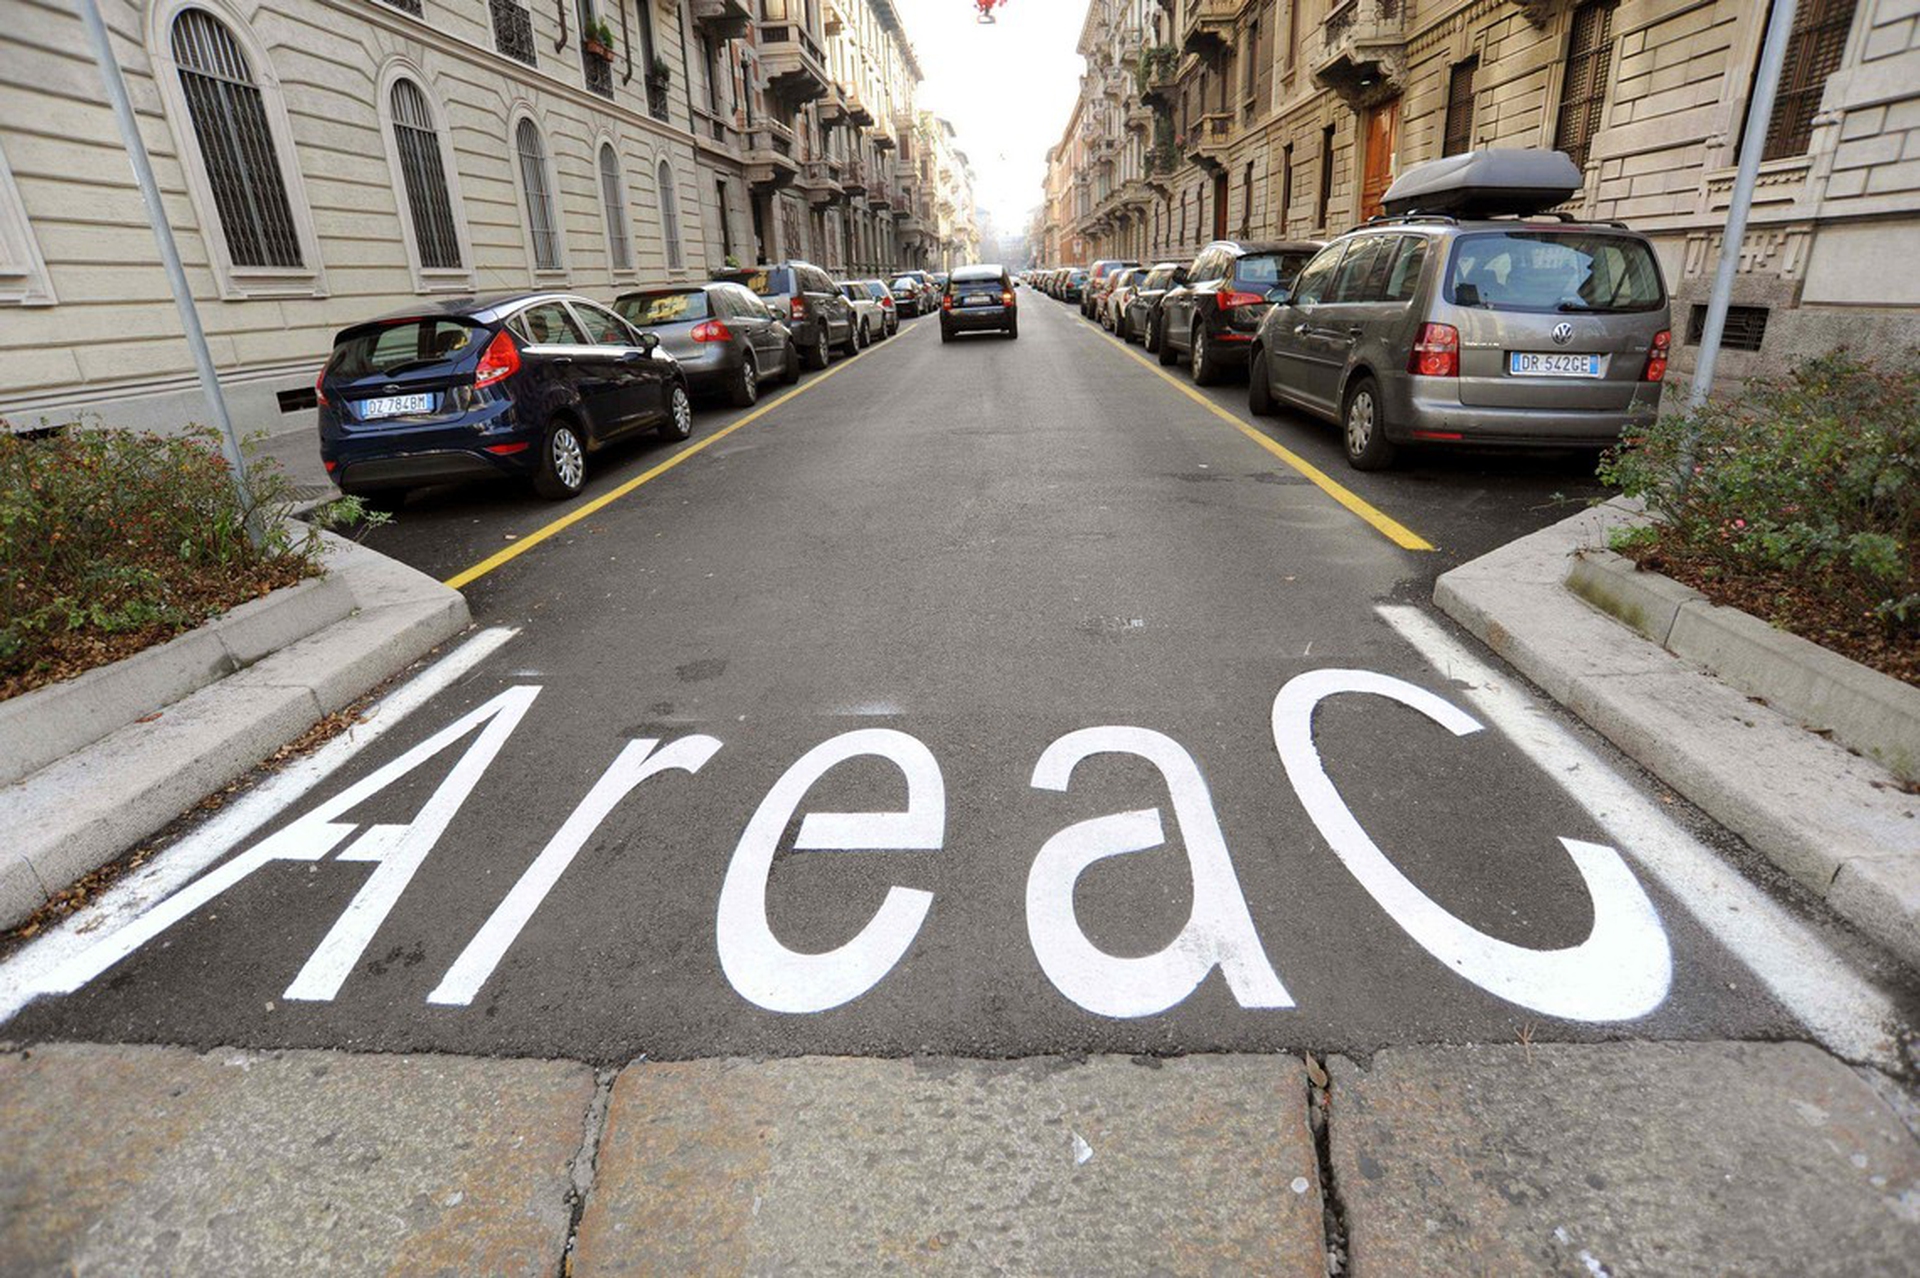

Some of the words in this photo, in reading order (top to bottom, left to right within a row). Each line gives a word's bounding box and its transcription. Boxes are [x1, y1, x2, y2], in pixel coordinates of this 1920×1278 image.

[1521, 355, 1539, 371] DR
[1545, 355, 1589, 373] 542GE
[2, 685, 1294, 1019] Area
[1271, 668, 1672, 1022] C
